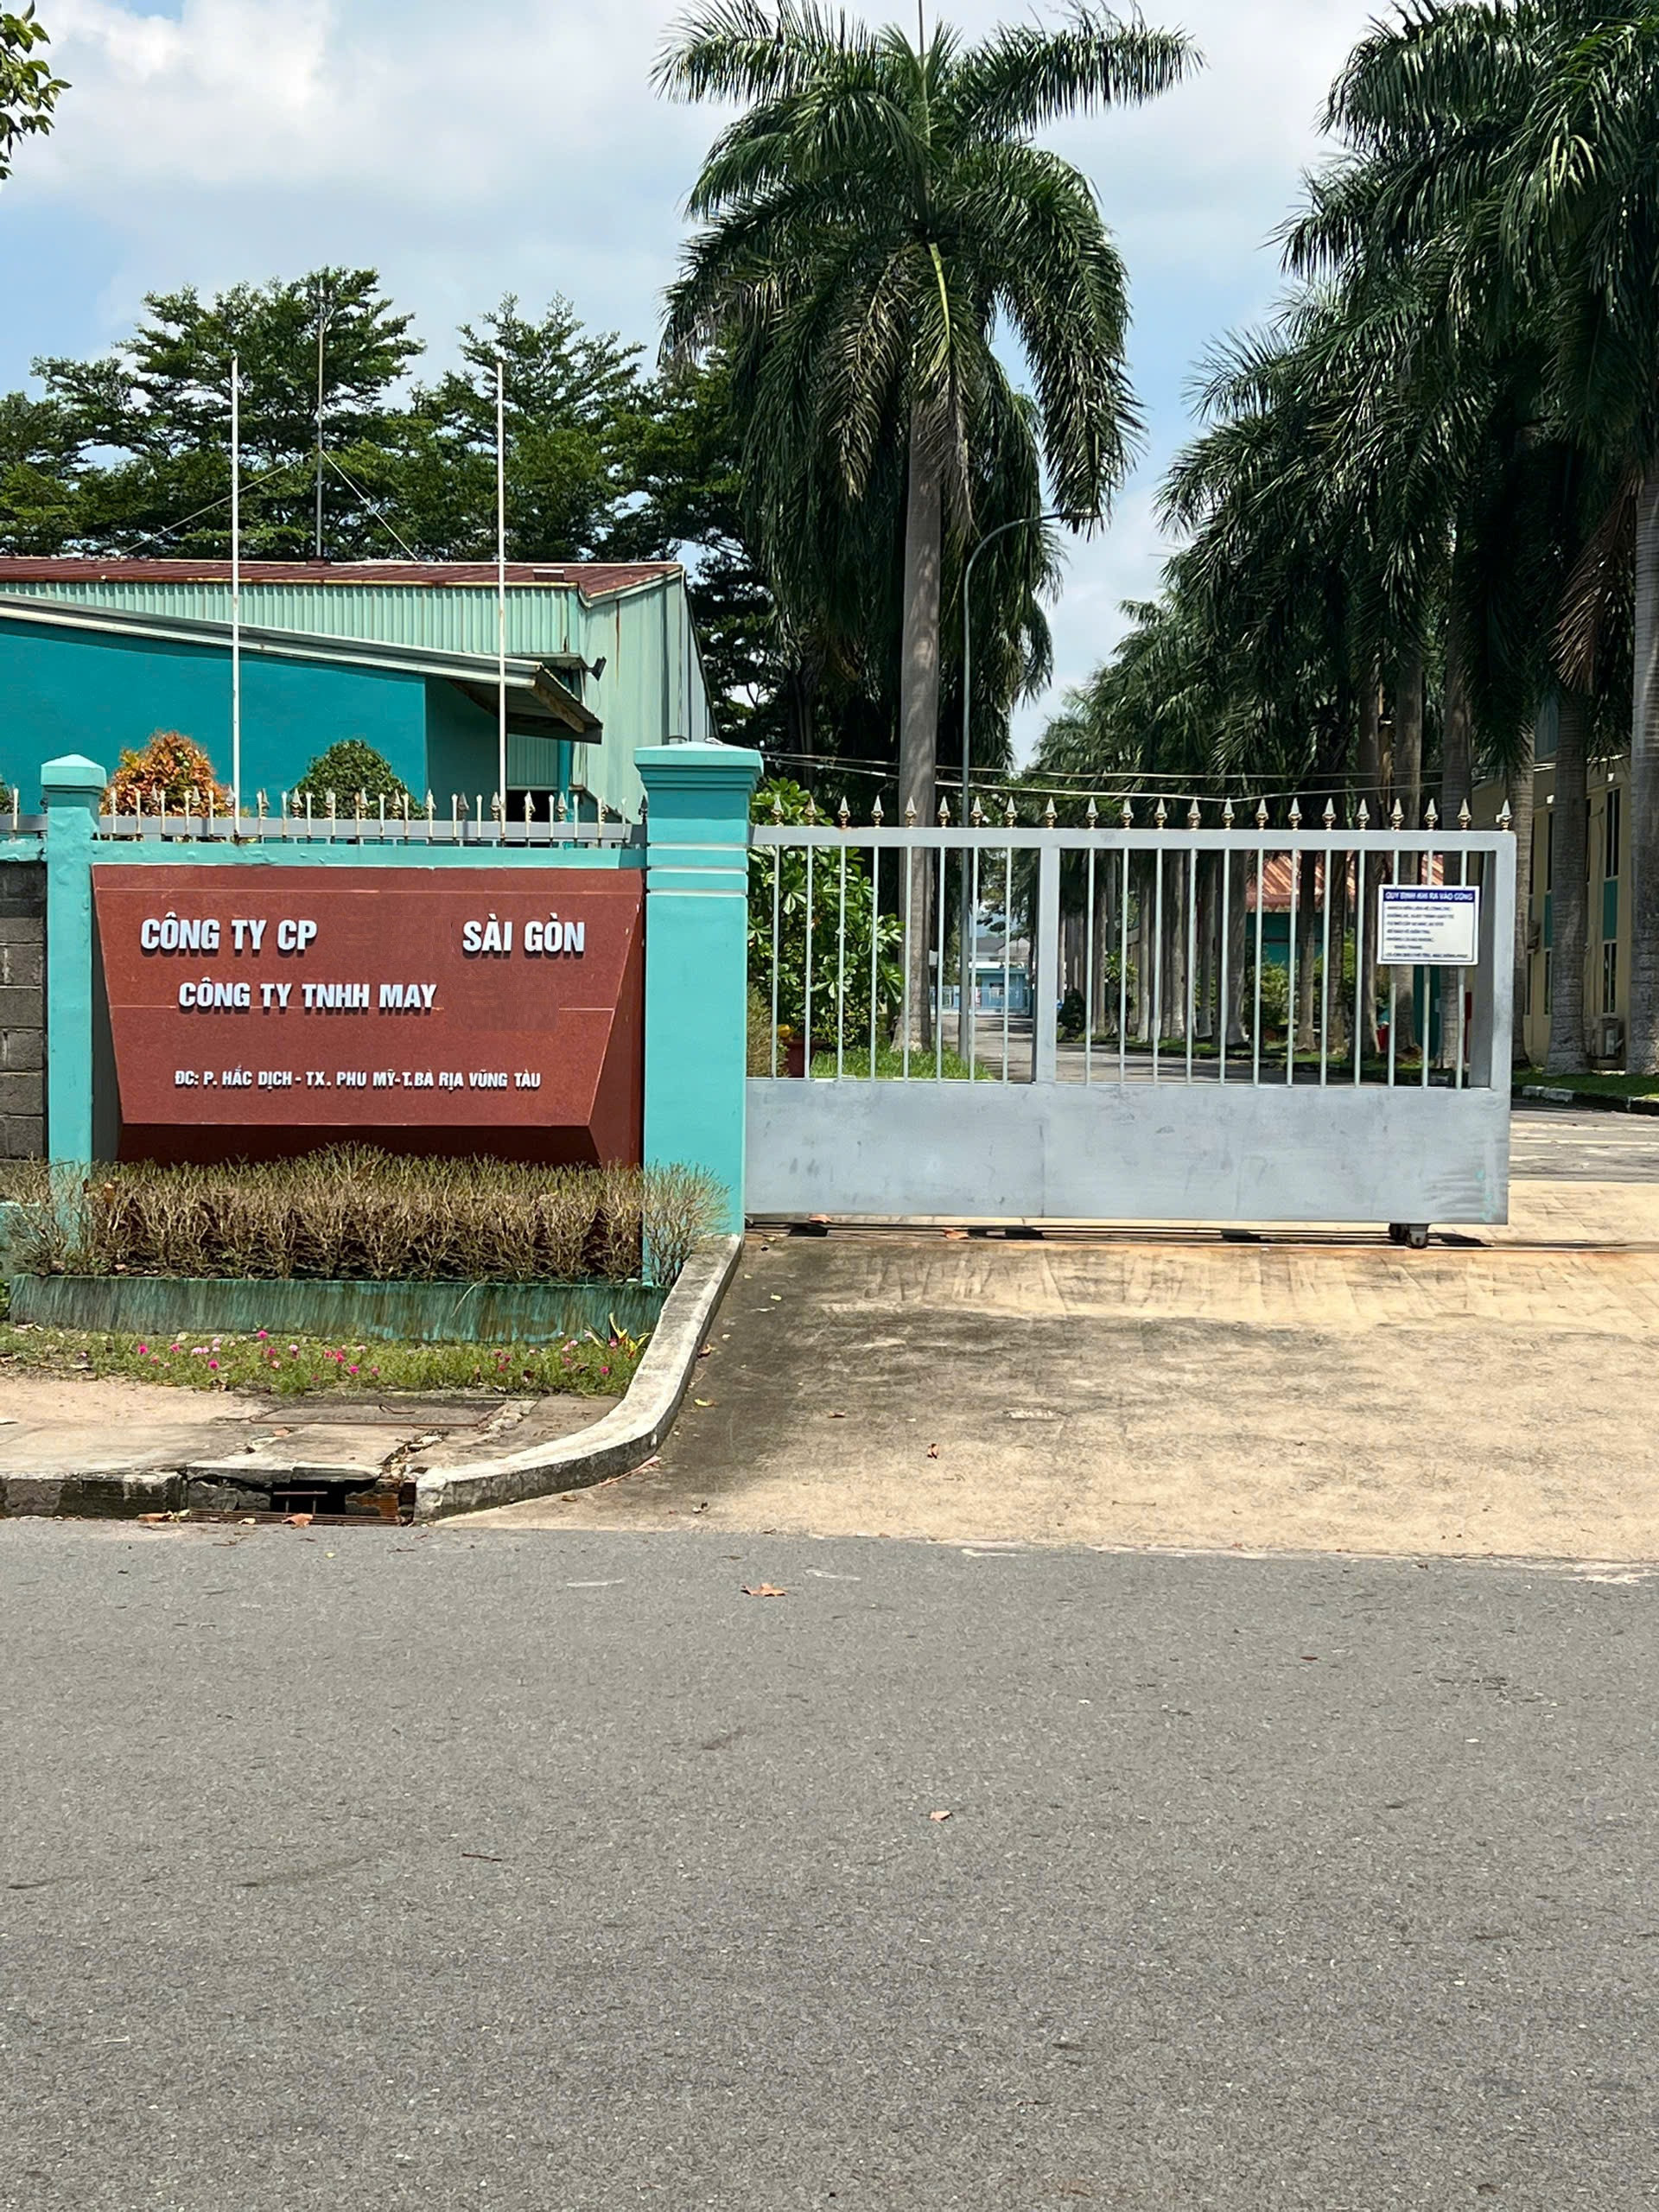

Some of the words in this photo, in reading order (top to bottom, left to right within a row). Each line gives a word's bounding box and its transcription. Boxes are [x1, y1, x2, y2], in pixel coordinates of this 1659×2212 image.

[141, 912, 220, 950] CÔNG
[231, 919, 267, 950] TY
[277, 920, 317, 951] CP
[462, 913, 512, 952] SÀI
[524, 912, 585, 952] GÒN
[179, 976, 251, 1007] CÔNG
[260, 983, 292, 1007] TY
[302, 983, 370, 1008] TNHH
[379, 984, 437, 1008] MAY
[203, 1071, 218, 1086] P.
[258, 1071, 293, 1090] DỊCH
[439, 1072, 464, 1090] RỊA
[514, 1068, 541, 1087] TÀU
